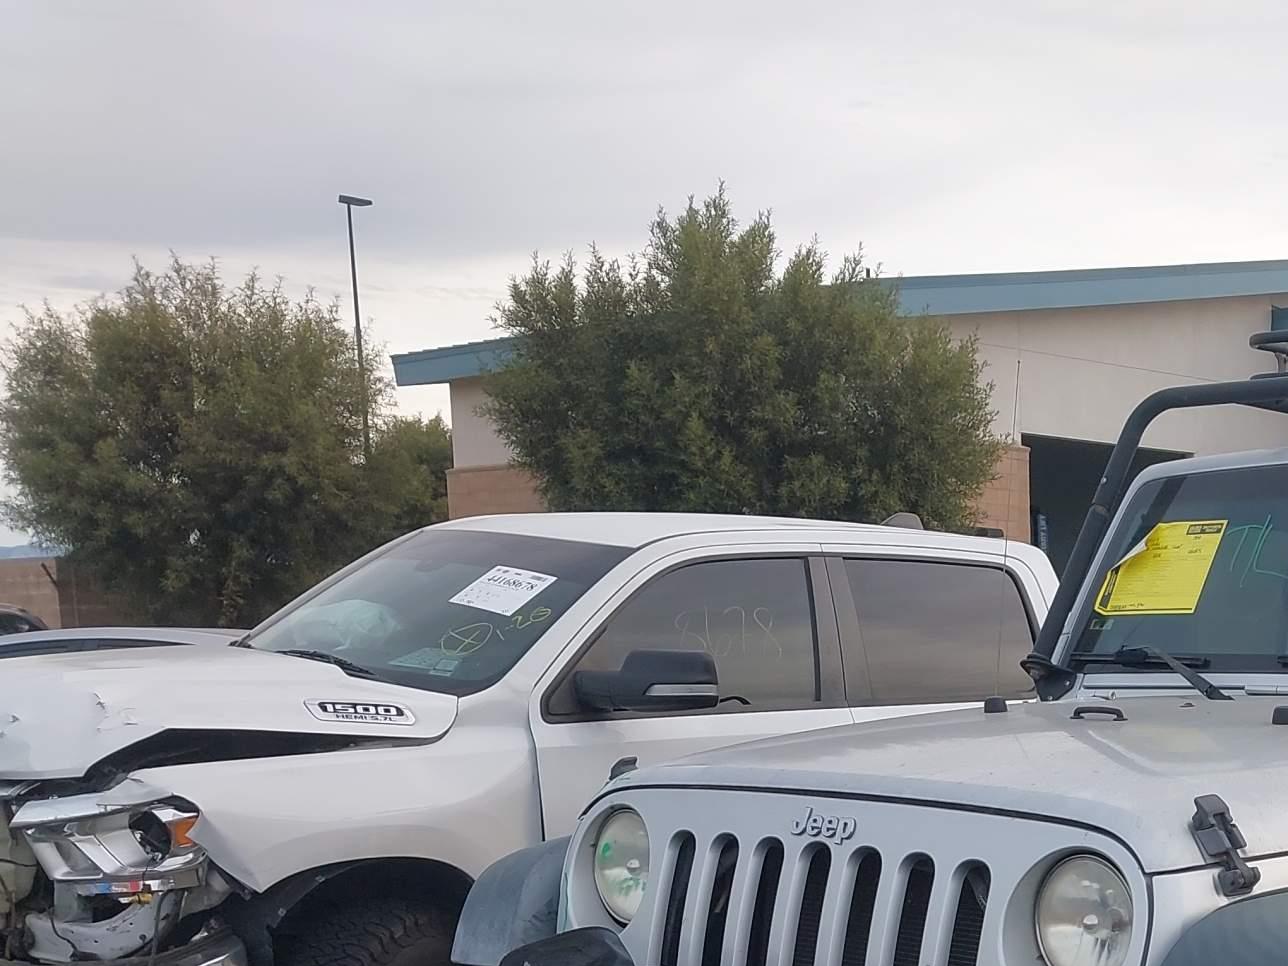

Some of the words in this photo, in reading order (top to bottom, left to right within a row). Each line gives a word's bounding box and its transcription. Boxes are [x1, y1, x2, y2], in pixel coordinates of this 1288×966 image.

[487, 574, 538, 592] 44168678
[322, 703, 398, 715] 1500
[791, 805, 857, 846] Jeep
